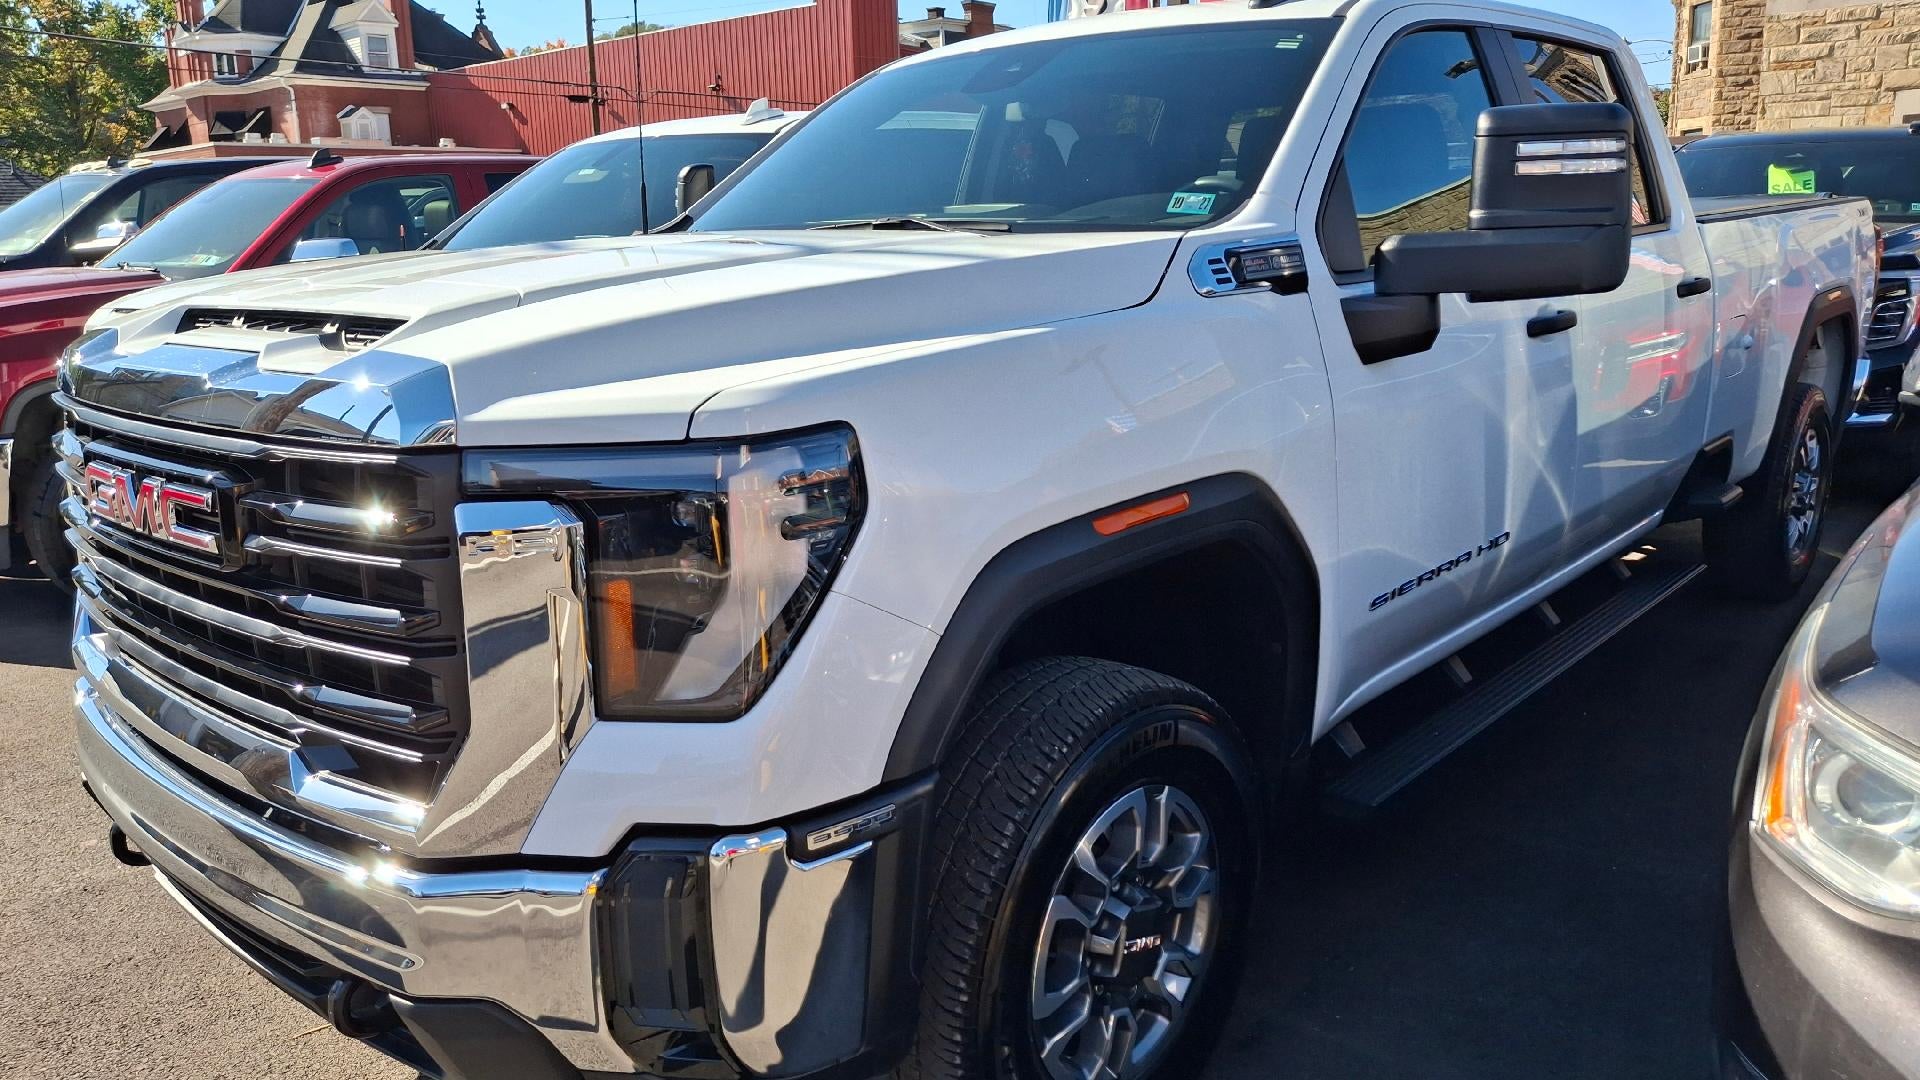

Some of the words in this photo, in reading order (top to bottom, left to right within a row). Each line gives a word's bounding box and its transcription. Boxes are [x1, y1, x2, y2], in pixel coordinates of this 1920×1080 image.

[1198, 196, 1212, 210] 27
[1771, 179, 1813, 193] SALE
[84, 460, 219, 554] GMC
[1368, 550, 1472, 612] SIERRA
[1476, 531, 1510, 557] HD
[810, 807, 894, 846] 3500
